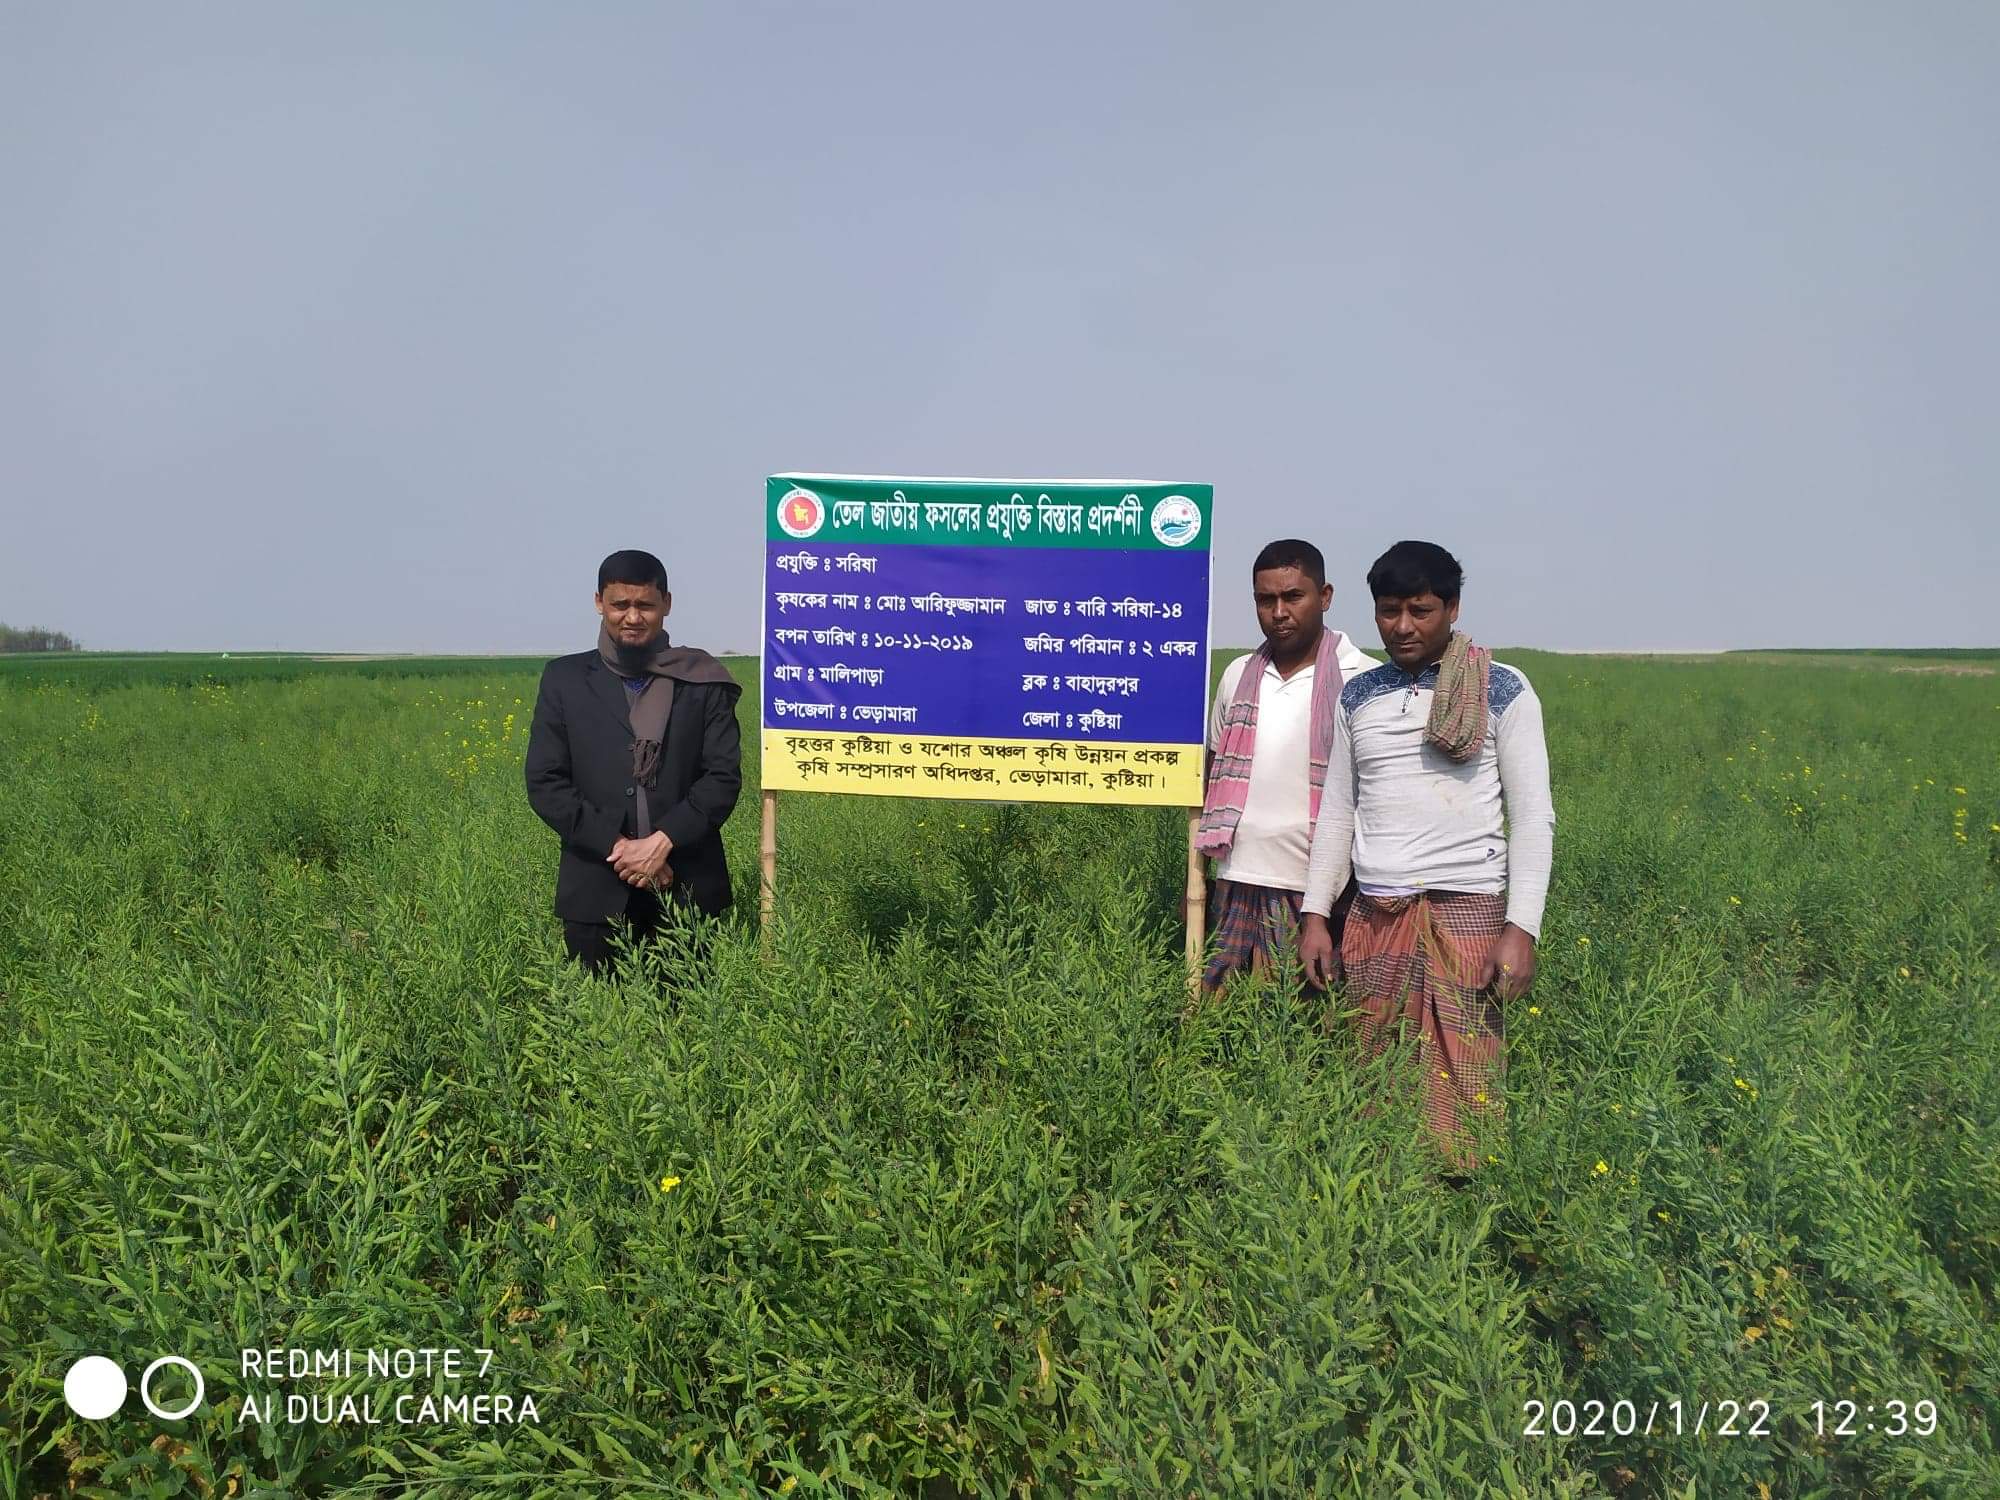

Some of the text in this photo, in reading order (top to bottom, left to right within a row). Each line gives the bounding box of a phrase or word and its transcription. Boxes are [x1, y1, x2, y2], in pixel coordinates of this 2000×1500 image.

[832, 501, 866, 530] তেল
[870, 490, 920, 531] জাতীয়
[923, 502, 982, 532] ফসলের
[986, 493, 1033, 541] প্রযুক্তি
[1037, 493, 1084, 535] বিস্তার
[1087, 493, 1144, 536] প্রদর্শনী
[775, 551, 818, 575] প্রযুক্তি
[835, 552, 878, 574] সরিষা
[775, 592, 827, 614] কৃষকের
[832, 594, 859, 610] নাম
[876, 595, 906, 612] মোঃ
[911, 592, 1006, 617] আরিফুজ্জামান
[1024, 599, 1058, 616] জাত
[1075, 596, 1106, 617] বারি
[1112, 597, 1183, 619] সরিষা-১৪
[775, 628, 809, 645] বপন
[812, 625, 856, 647] তারিখ
[874, 632, 973, 651] ১০-১১-২০১৯
[1023, 632, 1065, 653] জমির
[1069, 633, 1124, 656] পরিমান
[1142, 641, 1153, 658] ২
[1159, 641, 1198, 657] একর
[773, 663, 802, 682] গ্রাম
[819, 662, 884, 687] মালিপাড়া
[1022, 674, 1048, 692] ব্লক
[1065, 674, 1140, 697] বাহাদুরপুর
[773, 697, 835, 720] উপজেলা
[852, 704, 917, 724] ভেড়ামারা
[1022, 711, 1061, 728] জেলা
[1077, 708, 1122, 734] কুষ্টিয়া
[784, 735, 1181, 767] বৃহত্তর কুষ্টিয়া ও যশোর অঞ্চল কৃষি উন্নয়ন প্রকল্প
[796, 757, 830, 781] কৃষি
[836, 761, 917, 780] সম্প্রসারণ
[923, 762, 1000, 786] অধিদপ্তর,
[1009, 768, 1094, 789] ভেড়ামারা,
[1101, 768, 1154, 791] কুষ্টিয়া
